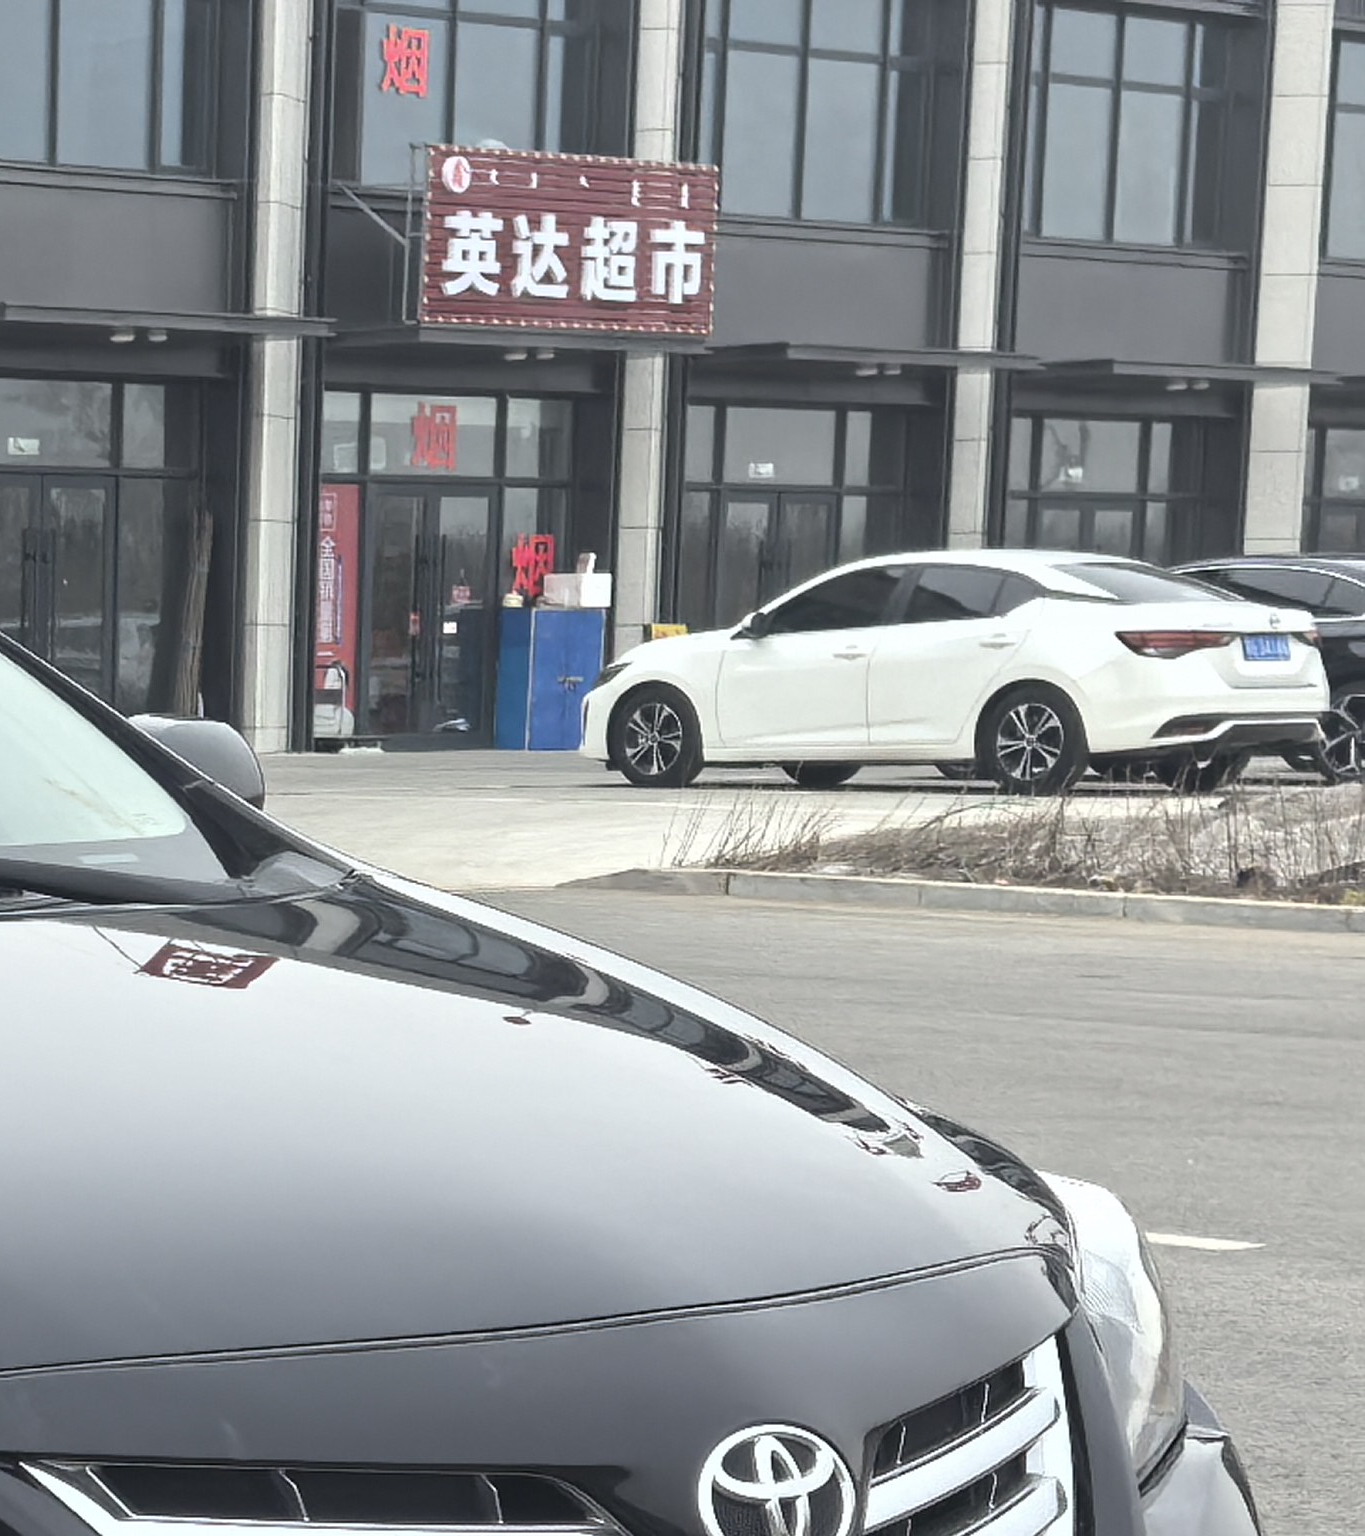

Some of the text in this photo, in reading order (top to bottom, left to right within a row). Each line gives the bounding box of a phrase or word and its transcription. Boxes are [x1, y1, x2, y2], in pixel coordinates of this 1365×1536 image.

[382, 24, 429, 97] 烟
[440, 211, 705, 304] 英达超市
